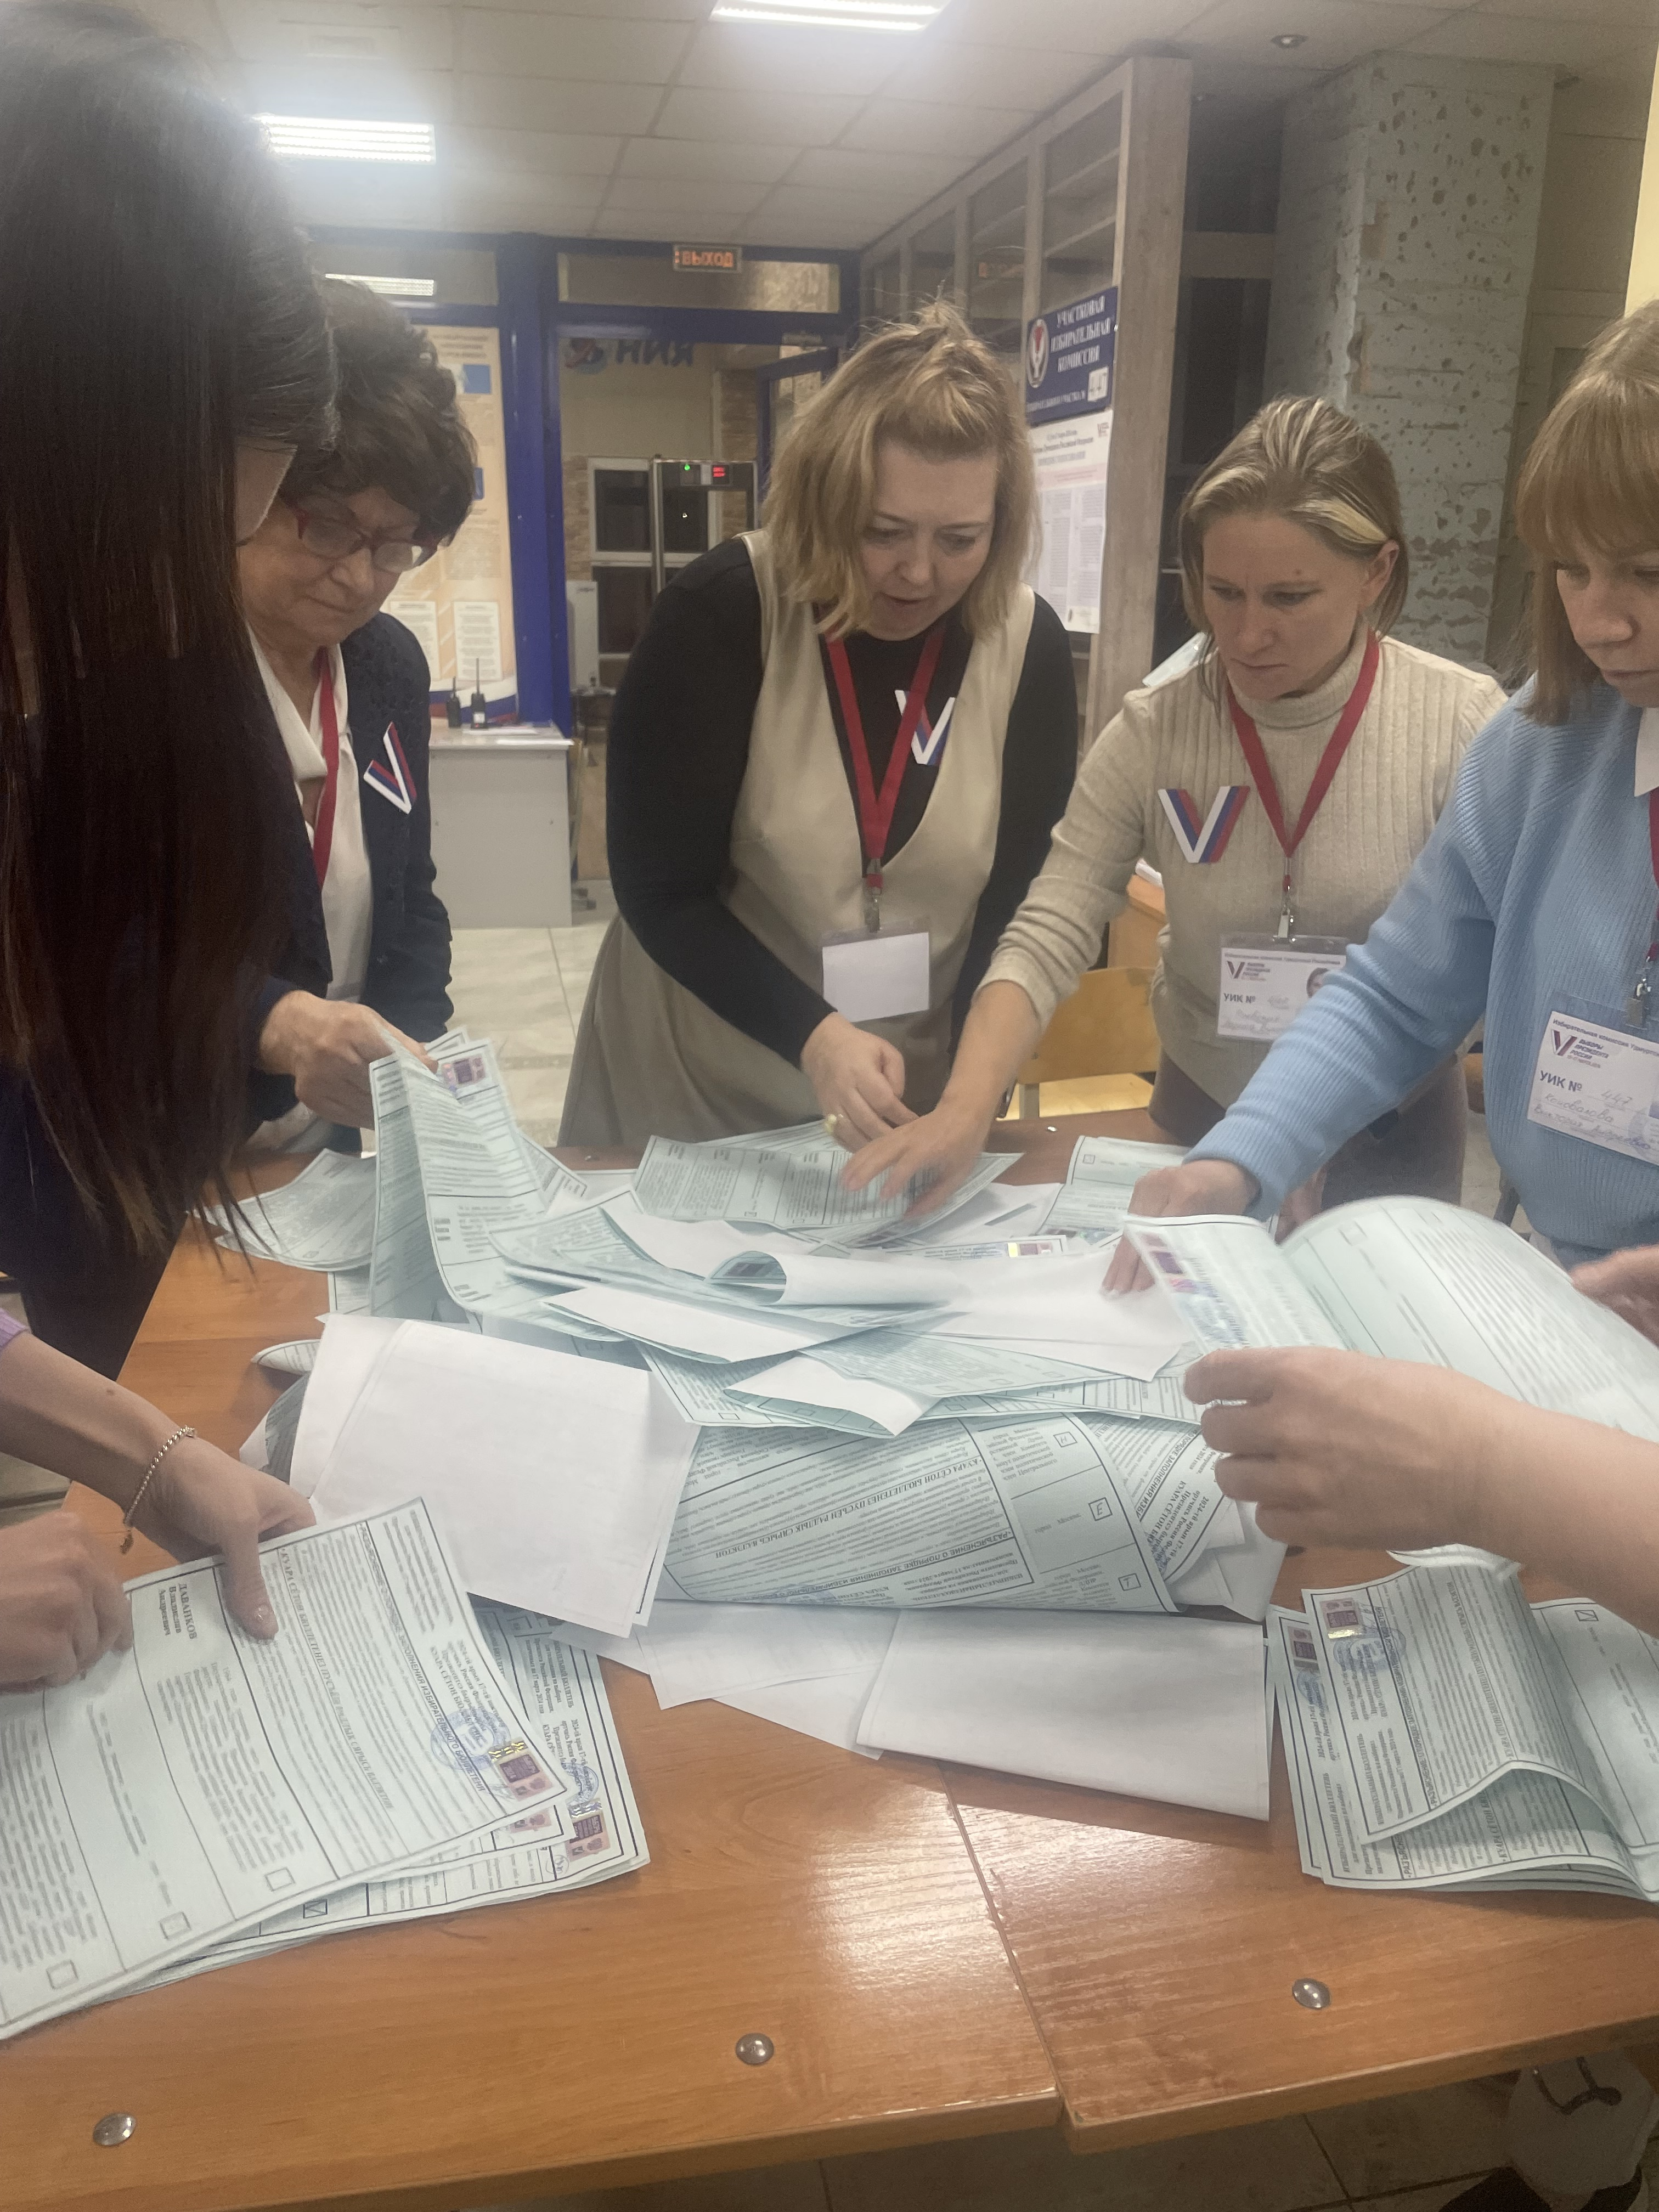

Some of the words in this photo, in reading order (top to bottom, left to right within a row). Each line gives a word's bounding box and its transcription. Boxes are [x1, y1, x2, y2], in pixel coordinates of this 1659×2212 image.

[1223, 993, 1243, 1002] УИК
[1538, 1069, 1567, 1088] УИК
[1566, 1080, 1583, 1094] №
[1171, 1435, 1190, 1457] ПОРЯДКЕ
[923, 1467, 952, 1484] СЁТОН
[952, 1458, 977, 1472] КУАРА
[1145, 1454, 1176, 1498] ЗАПОЛНЕНИЯ
[866, 1477, 923, 1506] БЮЛЛЕТЕНЕЗ
[1169, 1480, 1187, 1503] КУАРА
[830, 1500, 866, 1521] ПУСЪЁН
[1154, 1502, 1175, 1531] СЁТОН
[795, 1514, 829, 1533] РАДЛЫК
[1169, 1516, 1187, 1541] Россия
[759, 1527, 794, 1547] СЯРЫСЬ
[949, 1530, 1008, 1556] РАЗЪЯСНЕНИЕ
[902, 1553, 940, 1569] ПОРЯДКЕ
[849, 1564, 902, 1583] ЗАПОЛНЕНИЯ
[157, 1589, 171, 1636] Андреевич
[168, 1585, 182, 1633] Владислав
[178, 1582, 198, 1639] ДАВАНКОВ
[460, 1667, 475, 1690] Россия
[420, 1684, 461, 1750] ИЗБИРАТЕЛЬНОГО
[566, 1740, 575, 1757] Россия
[1483, 1809, 1499, 1833] СЁТОН
[1492, 1835, 1507, 1858] КУАРА
